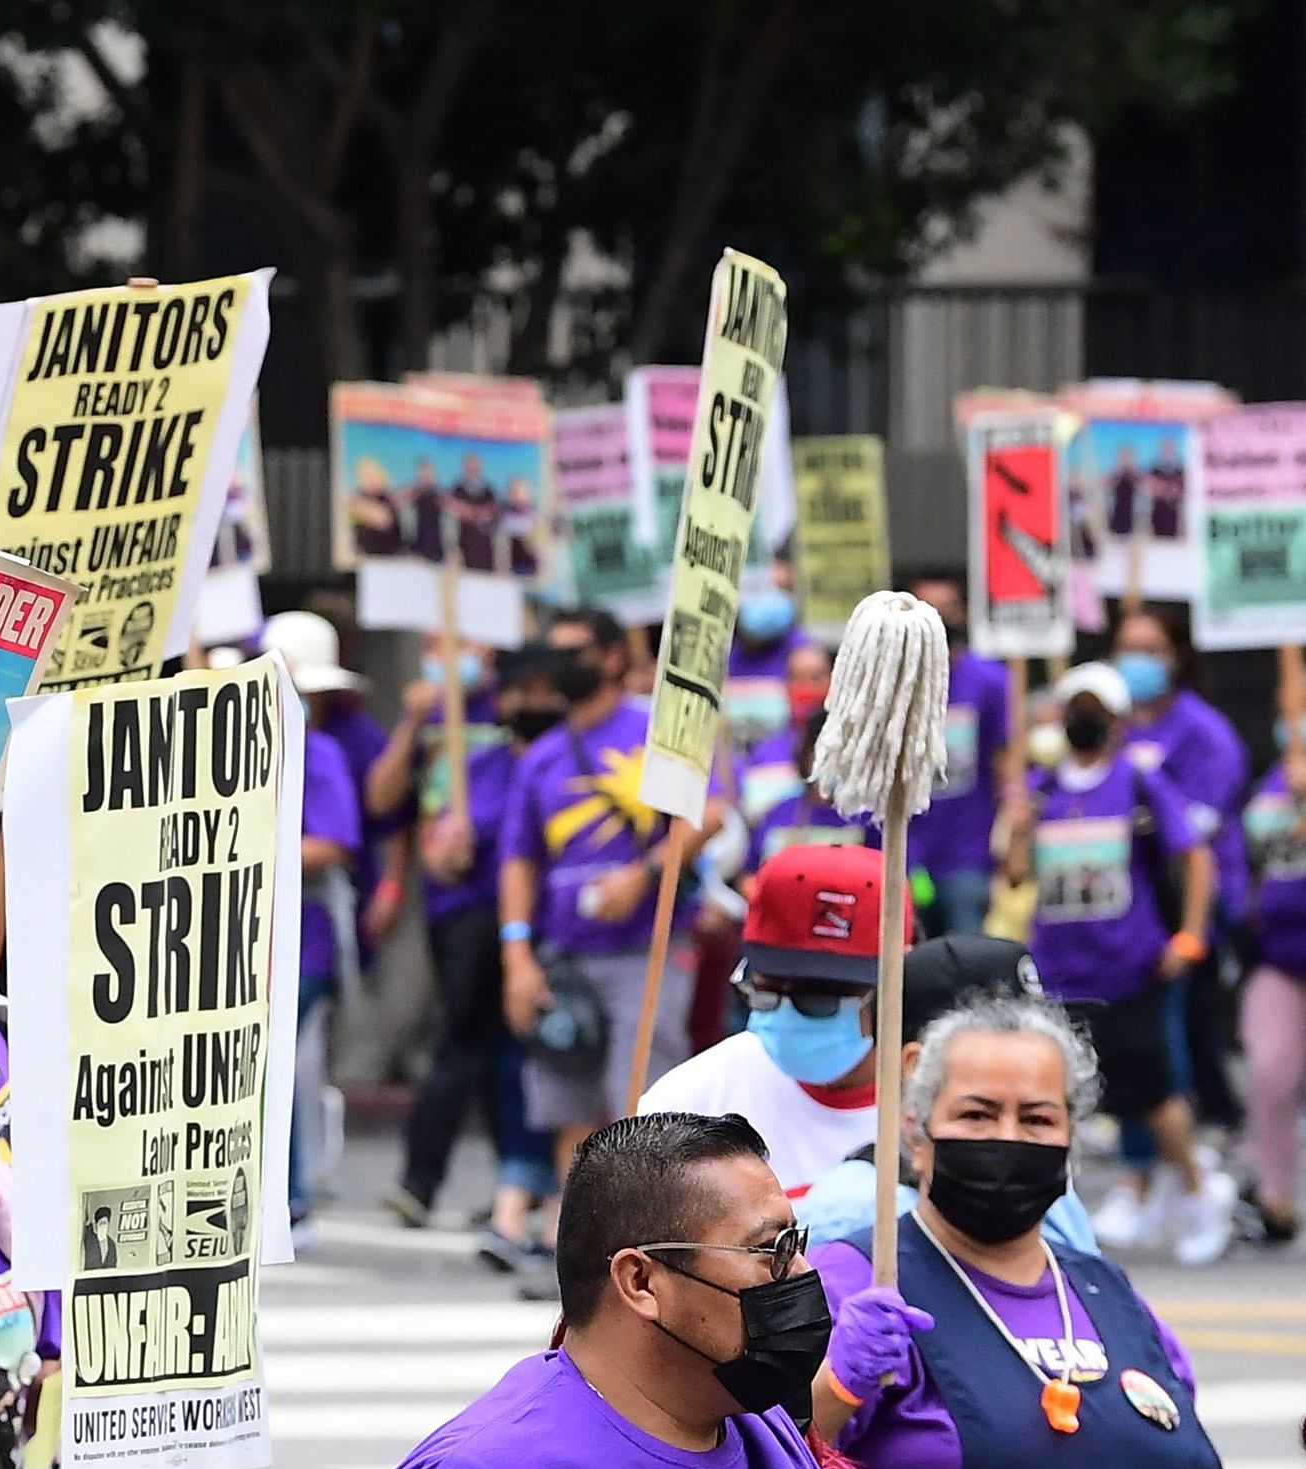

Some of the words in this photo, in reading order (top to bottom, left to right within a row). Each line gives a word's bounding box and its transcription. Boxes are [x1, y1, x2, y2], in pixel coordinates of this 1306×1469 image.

[27, 289, 235, 382] JANITORS
[73, 380, 153, 418] READY
[154, 376, 172, 412] 2
[6, 409, 206, 519] STRIKE
[90, 513, 182, 573] UNFAIR
[227, 806, 240, 863] 2
[92, 861, 263, 1024] STRIKE
[72, 1047, 175, 1128] Against
[120, 1211, 148, 1231] NOT
[185, 1234, 231, 1259] SEIU
[73, 1285, 207, 1385] UNFAIR:
[73, 1408, 127, 1444] UNITED
